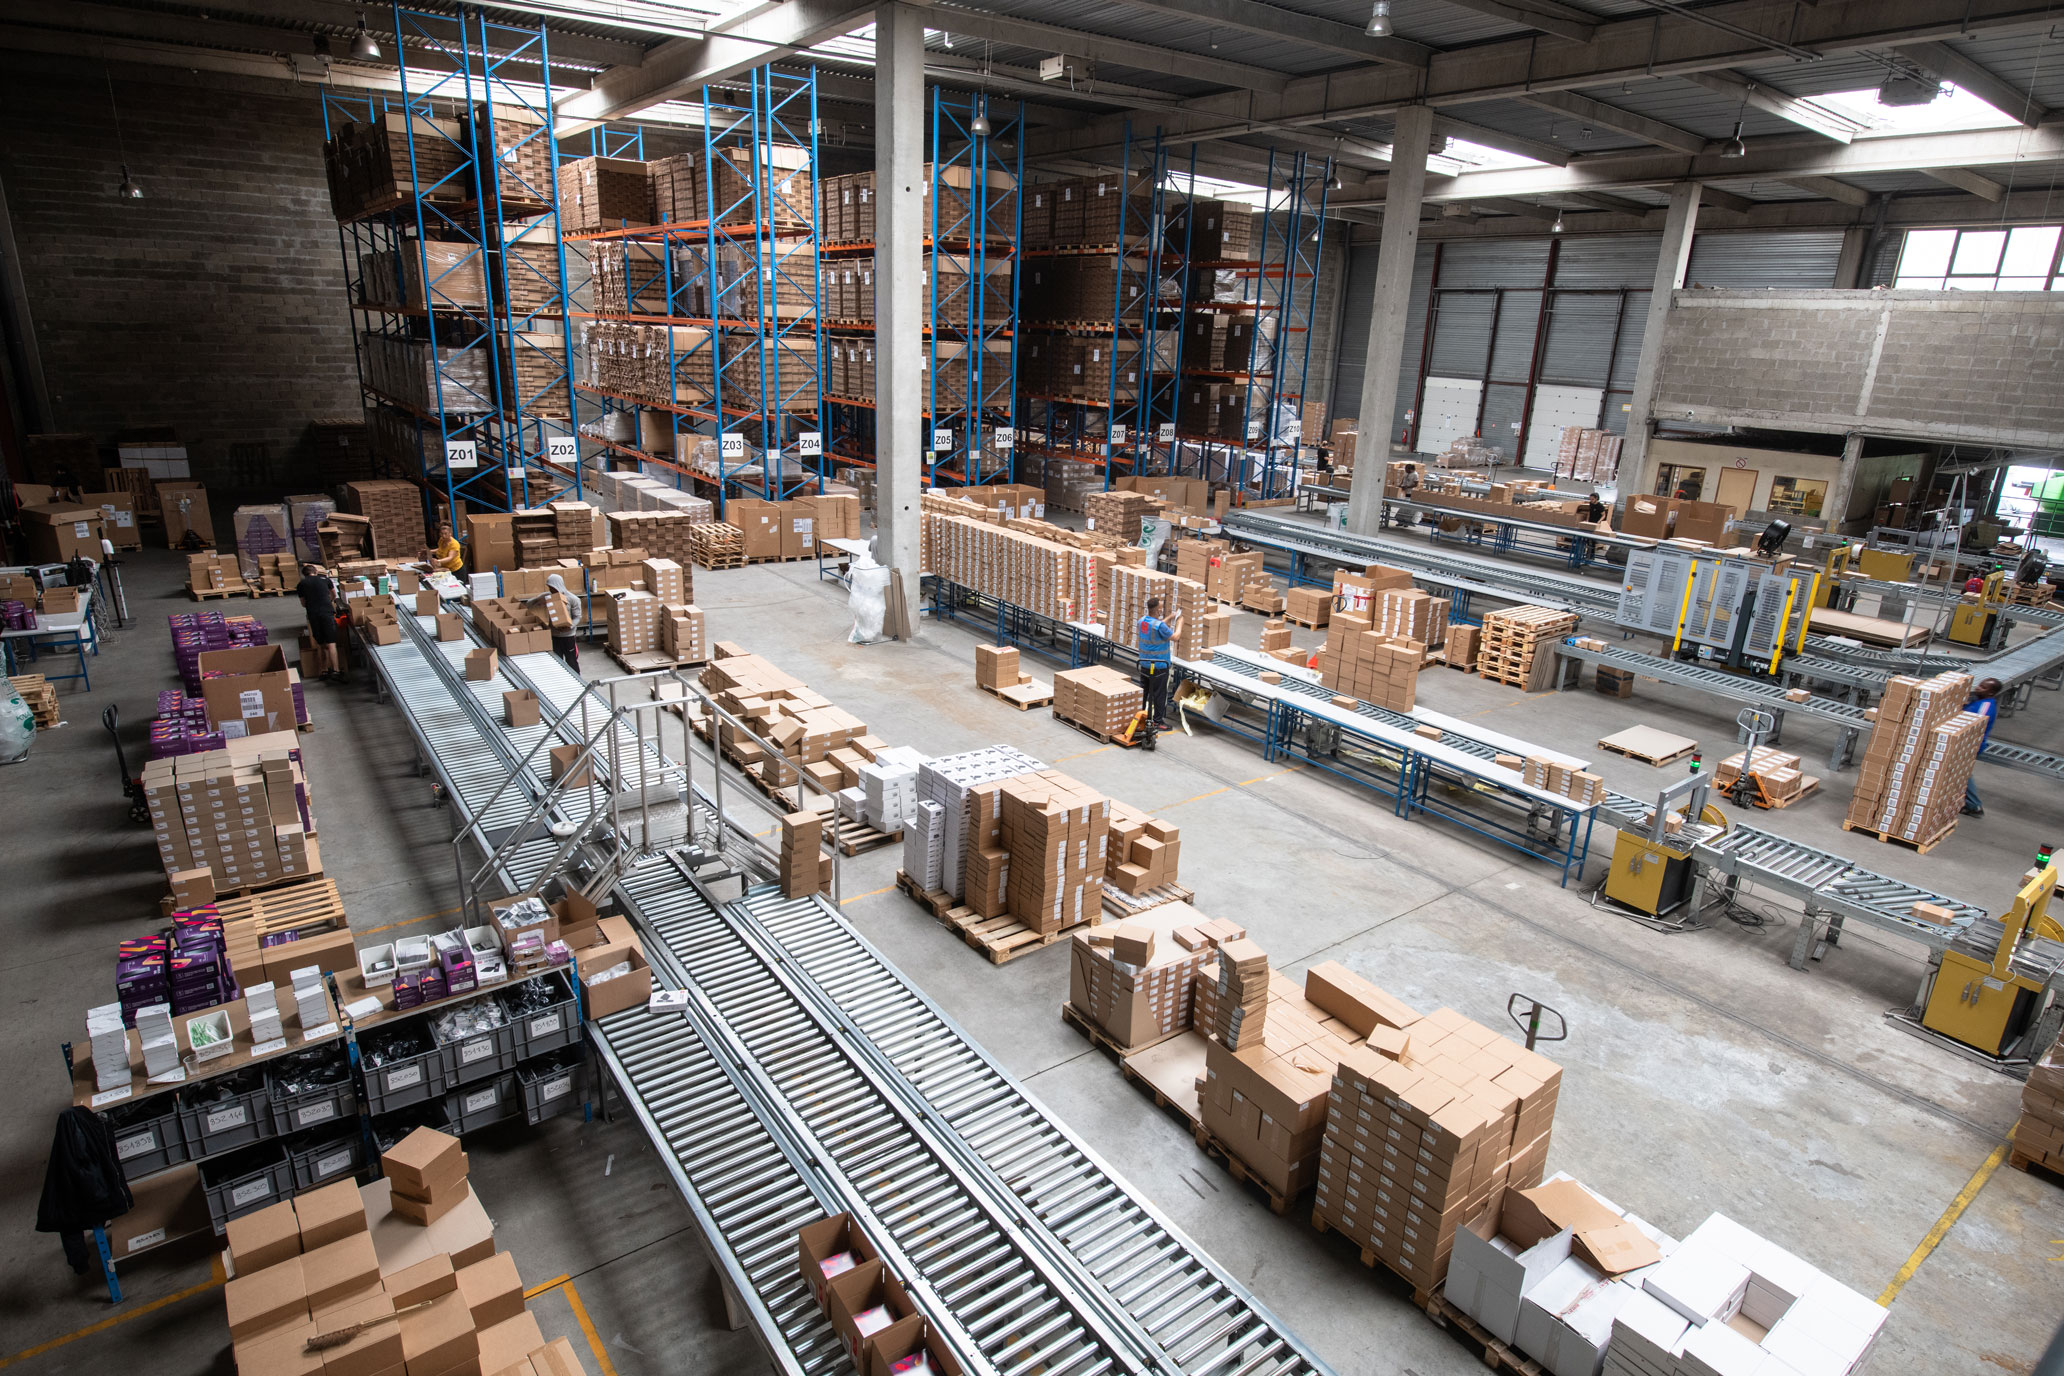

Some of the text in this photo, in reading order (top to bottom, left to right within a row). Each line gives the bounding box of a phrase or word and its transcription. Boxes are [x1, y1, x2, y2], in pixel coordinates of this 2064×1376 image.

[996, 433, 1013, 442] Z06
[1111, 430, 1125, 438] Z07
[1160, 428, 1174, 437] Z08
[722, 440, 742, 450] Z03
[801, 439, 820, 449] Z04
[935, 435, 951, 445] Z05
[449, 449, 474, 460] Z01
[550, 444, 575, 456] Z02
